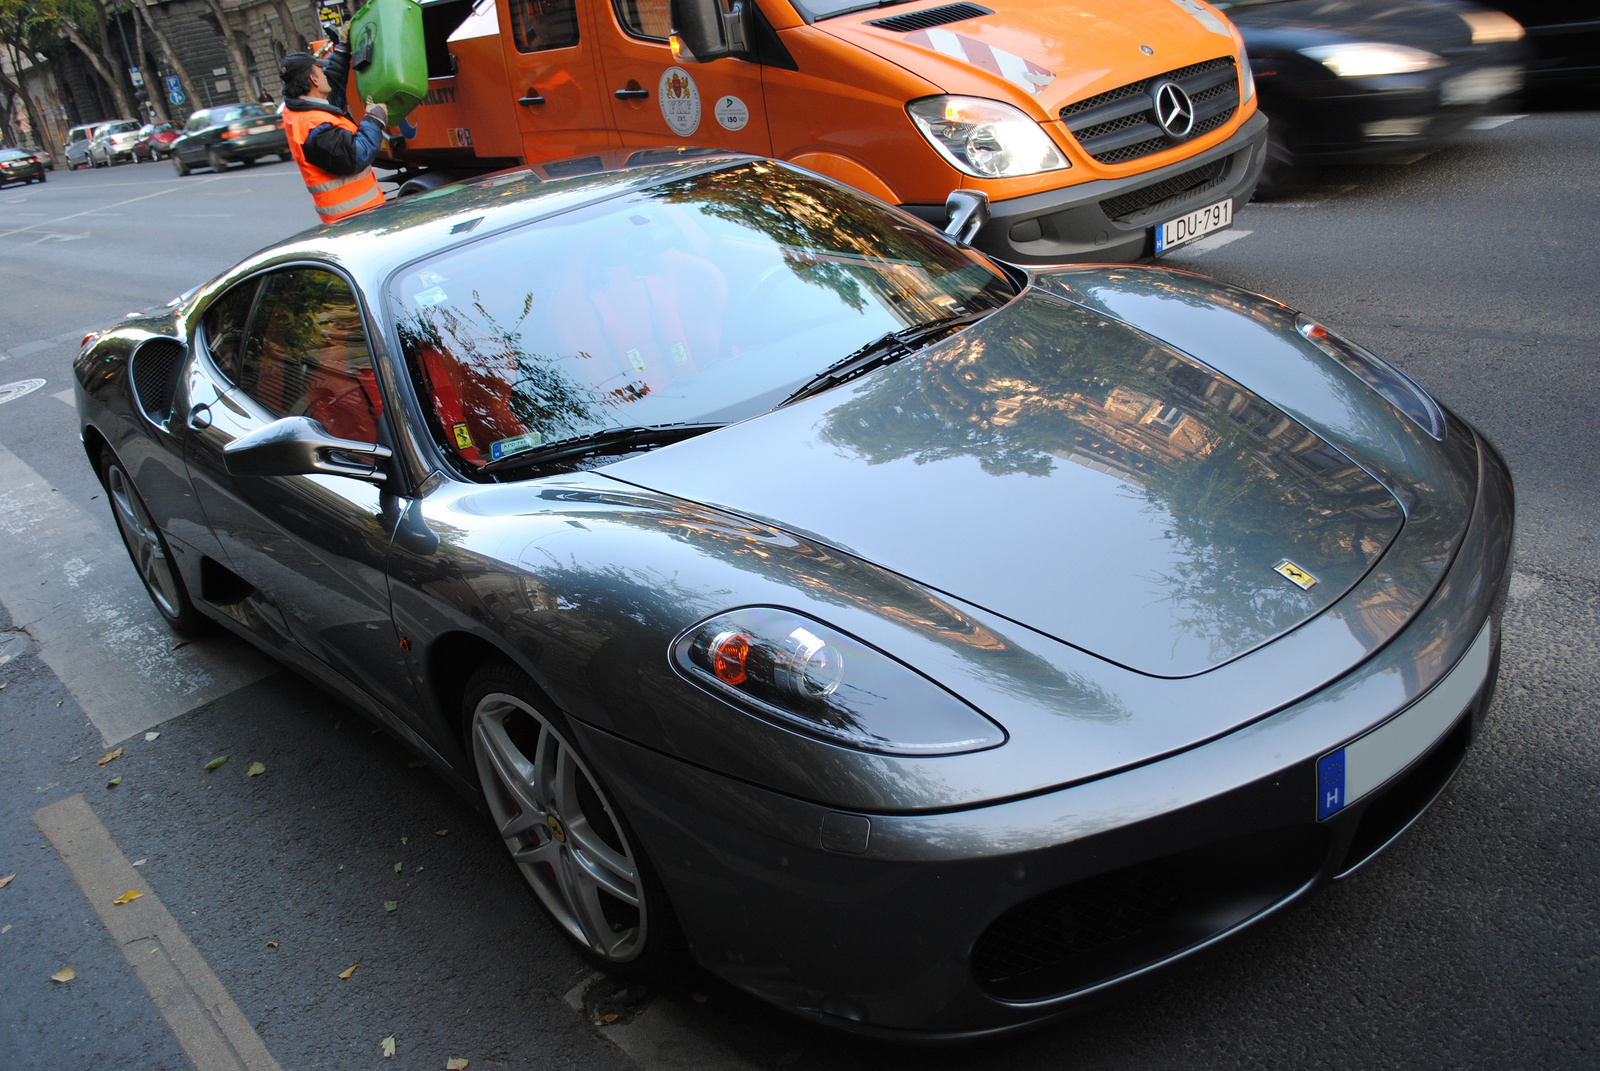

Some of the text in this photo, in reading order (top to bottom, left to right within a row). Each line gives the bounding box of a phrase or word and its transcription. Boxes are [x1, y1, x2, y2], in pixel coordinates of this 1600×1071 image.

[668, 100, 692, 115] FKF
[1166, 202, 1228, 246] LDU-791
[1157, 240, 1162, 249] H
[1326, 788, 1339, 808] H
